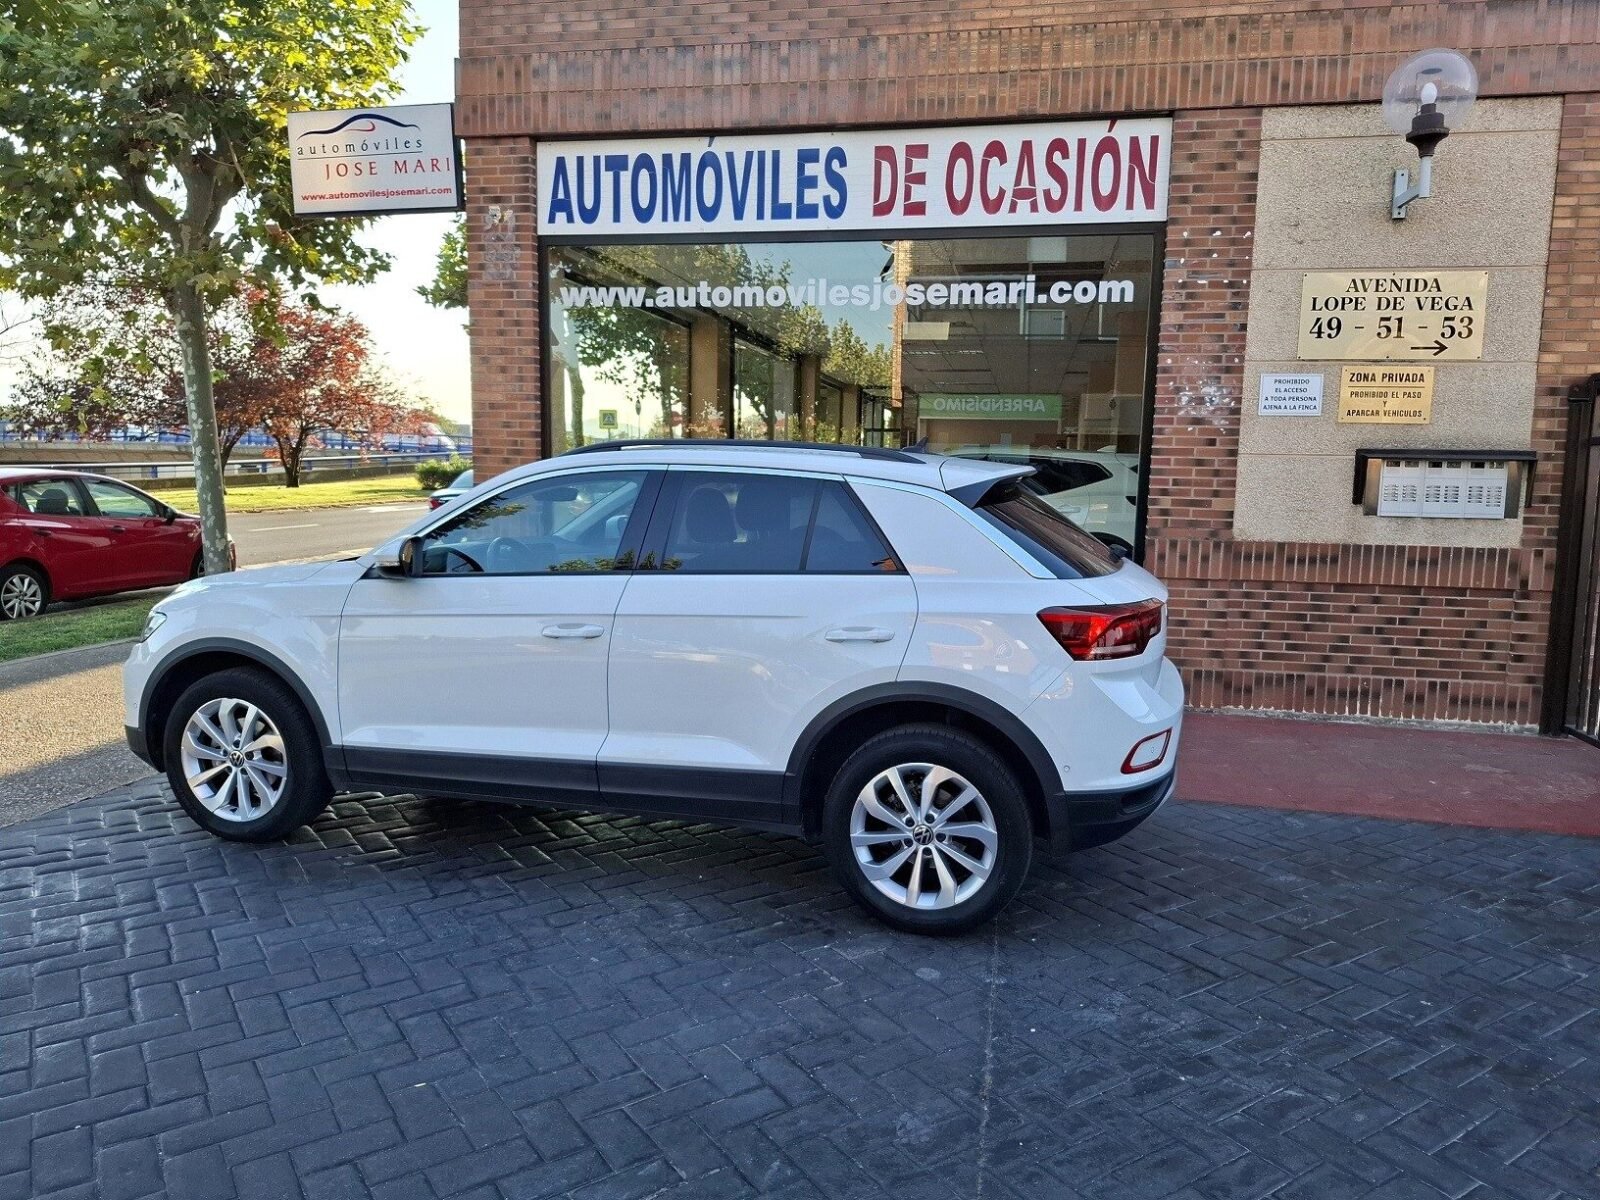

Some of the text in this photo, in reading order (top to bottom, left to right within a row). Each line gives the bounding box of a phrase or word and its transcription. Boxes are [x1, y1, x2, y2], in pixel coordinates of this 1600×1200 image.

[297, 137, 422, 156] automóviles
[325, 157, 451, 180] JOSE MARI
[548, 119, 1160, 225] AUTOMÓVILES DE OCASIÓN
[301, 187, 452, 202] www.automovilesjosemari.com
[560, 274, 1135, 312] www.automovilesjosemari.com
[1345, 278, 1442, 293] AVENIDA
[1311, 296, 1474, 311] LOPE DE VEGA
[1309, 316, 1342, 339] 49
[1376, 316, 1404, 339] 51
[1440, 316, 1474, 339] 53
[1349, 372, 1425, 383] ZONA PRIVADA
[1350, 391, 1422, 399] PROHIBIDO EL PASO
[1382, 400, 1388, 408] Y
[1346, 409, 1422, 418] APARCAR VEHICULOS
